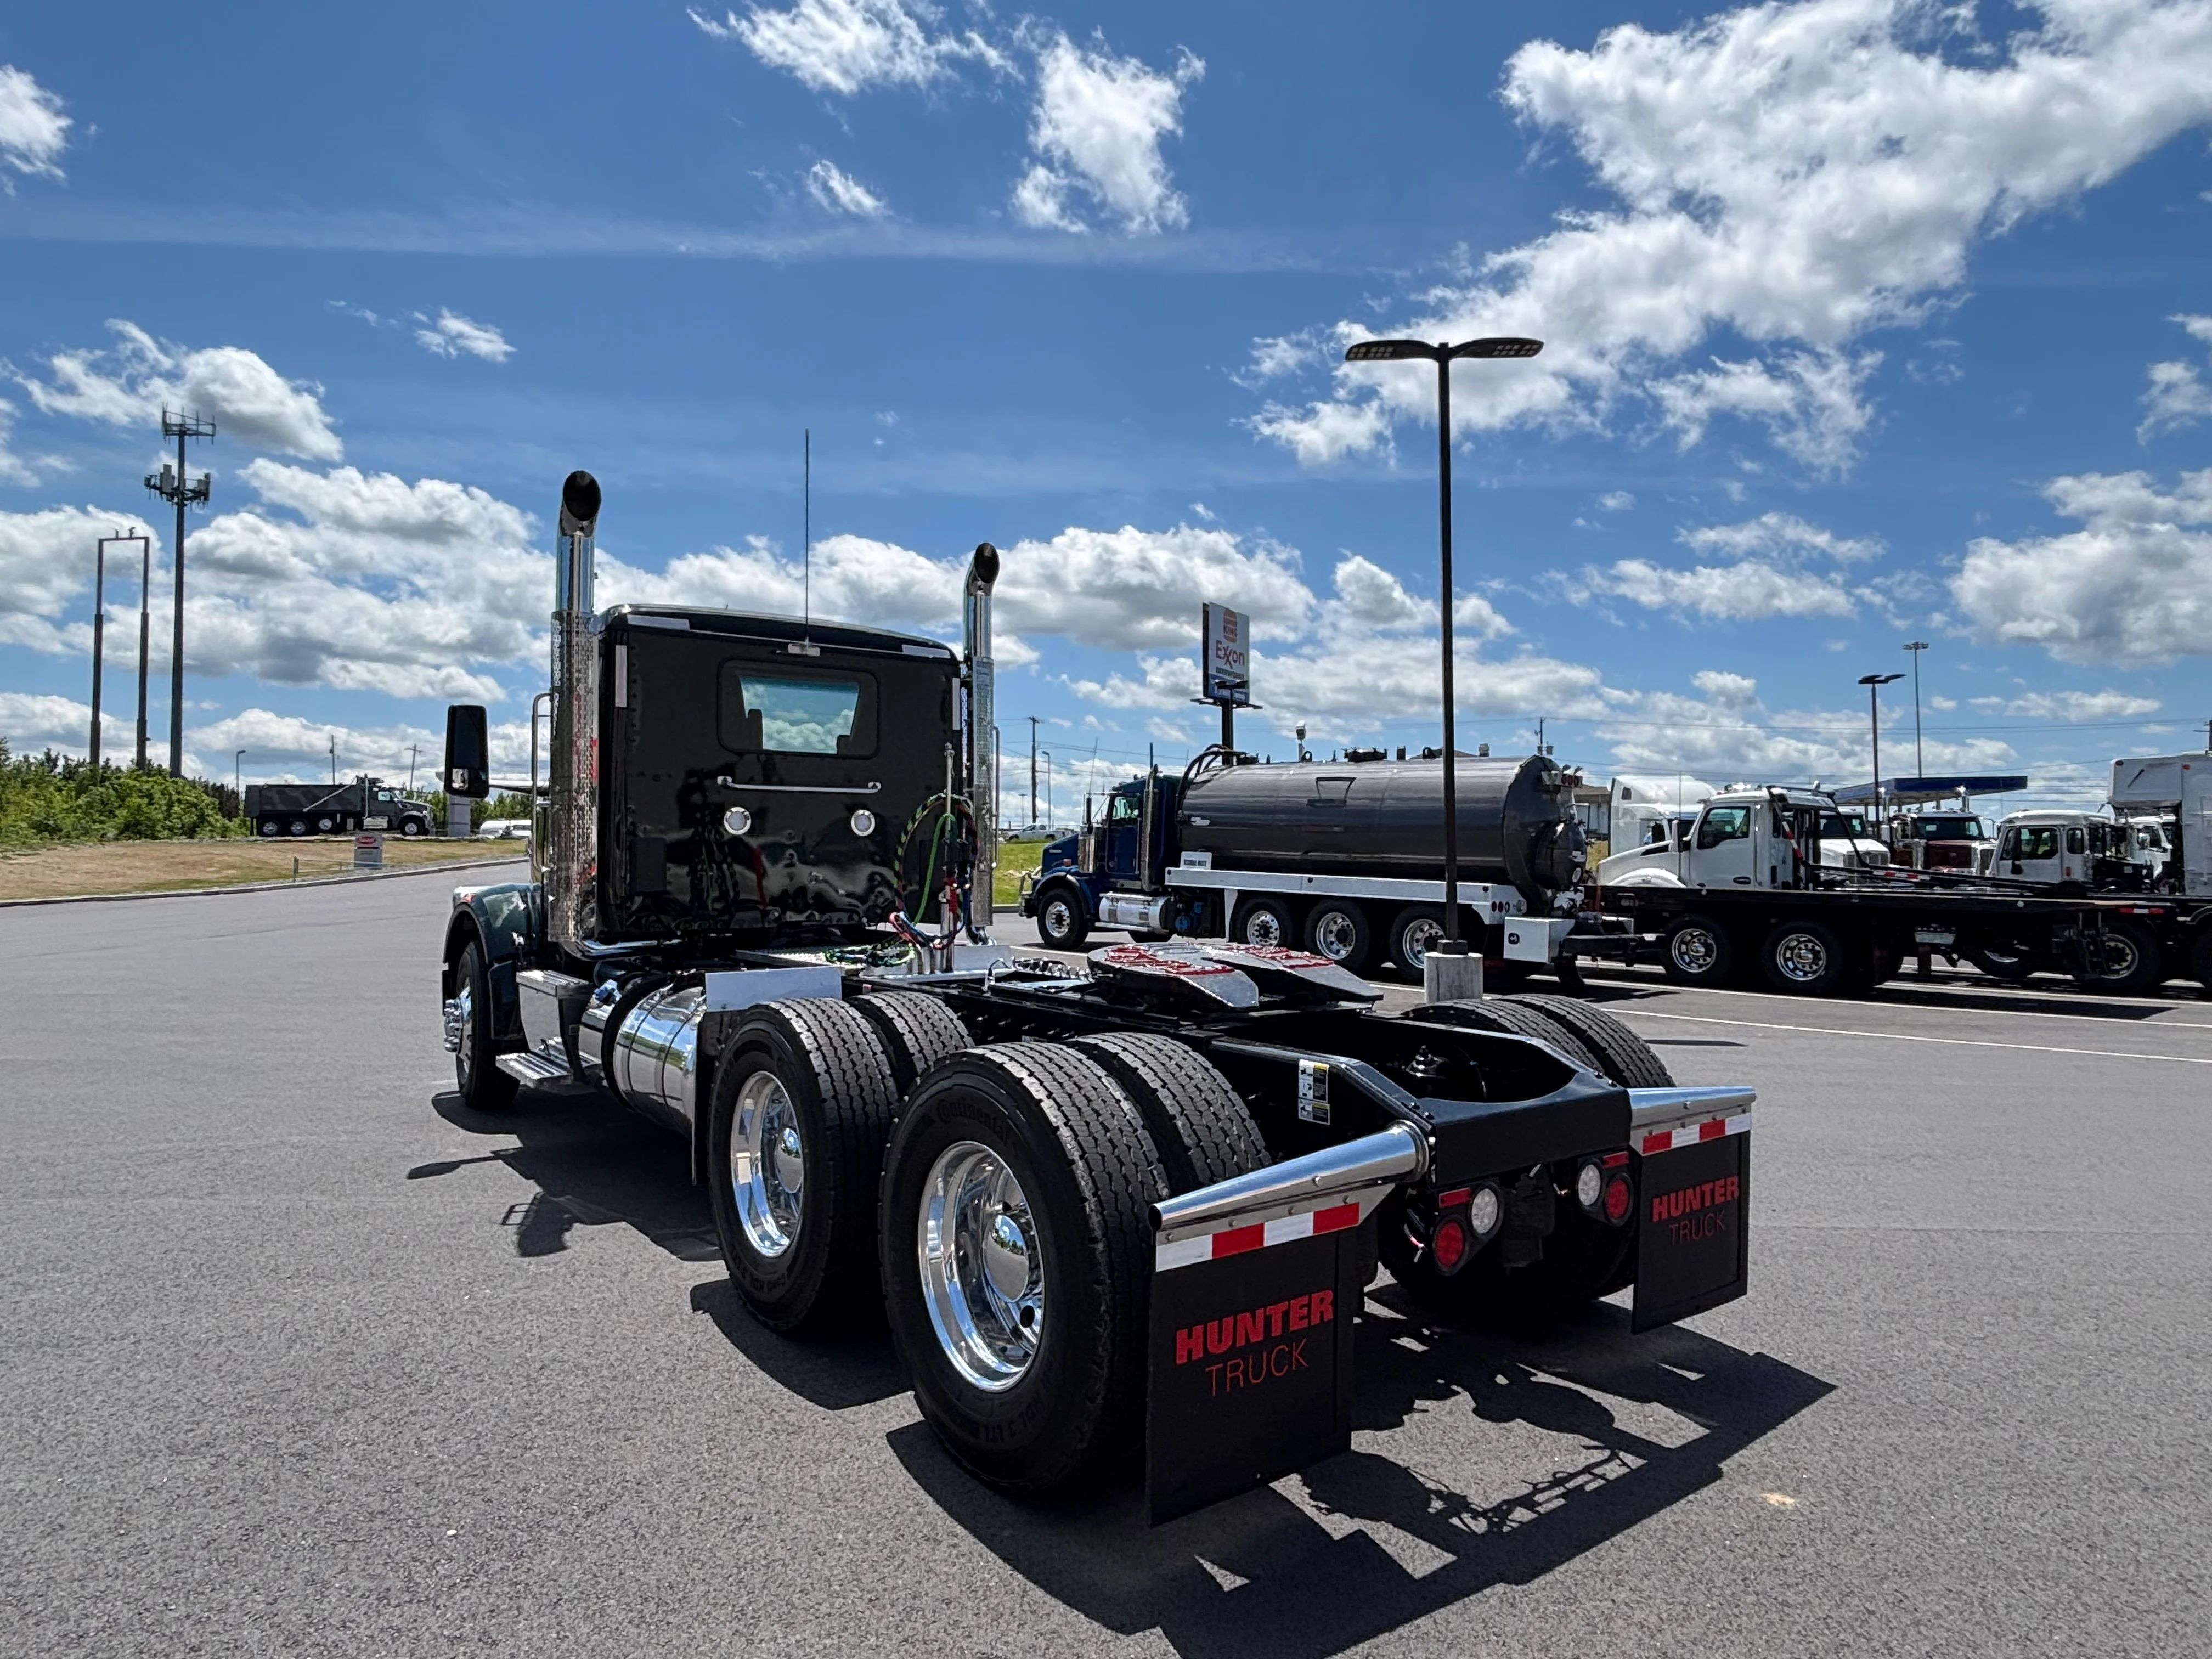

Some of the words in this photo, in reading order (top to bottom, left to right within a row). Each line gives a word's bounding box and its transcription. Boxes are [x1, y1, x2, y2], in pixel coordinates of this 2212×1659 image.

[1216, 640, 1245, 669] Exxon
[936, 1097, 1009, 1147] Continental
[1652, 1175, 1739, 1222] HUNTER
[1668, 1210, 1725, 1246] TRUCK
[1176, 1289, 1334, 1365] HUNTER
[1205, 1339, 1308, 1397] TRUCK
